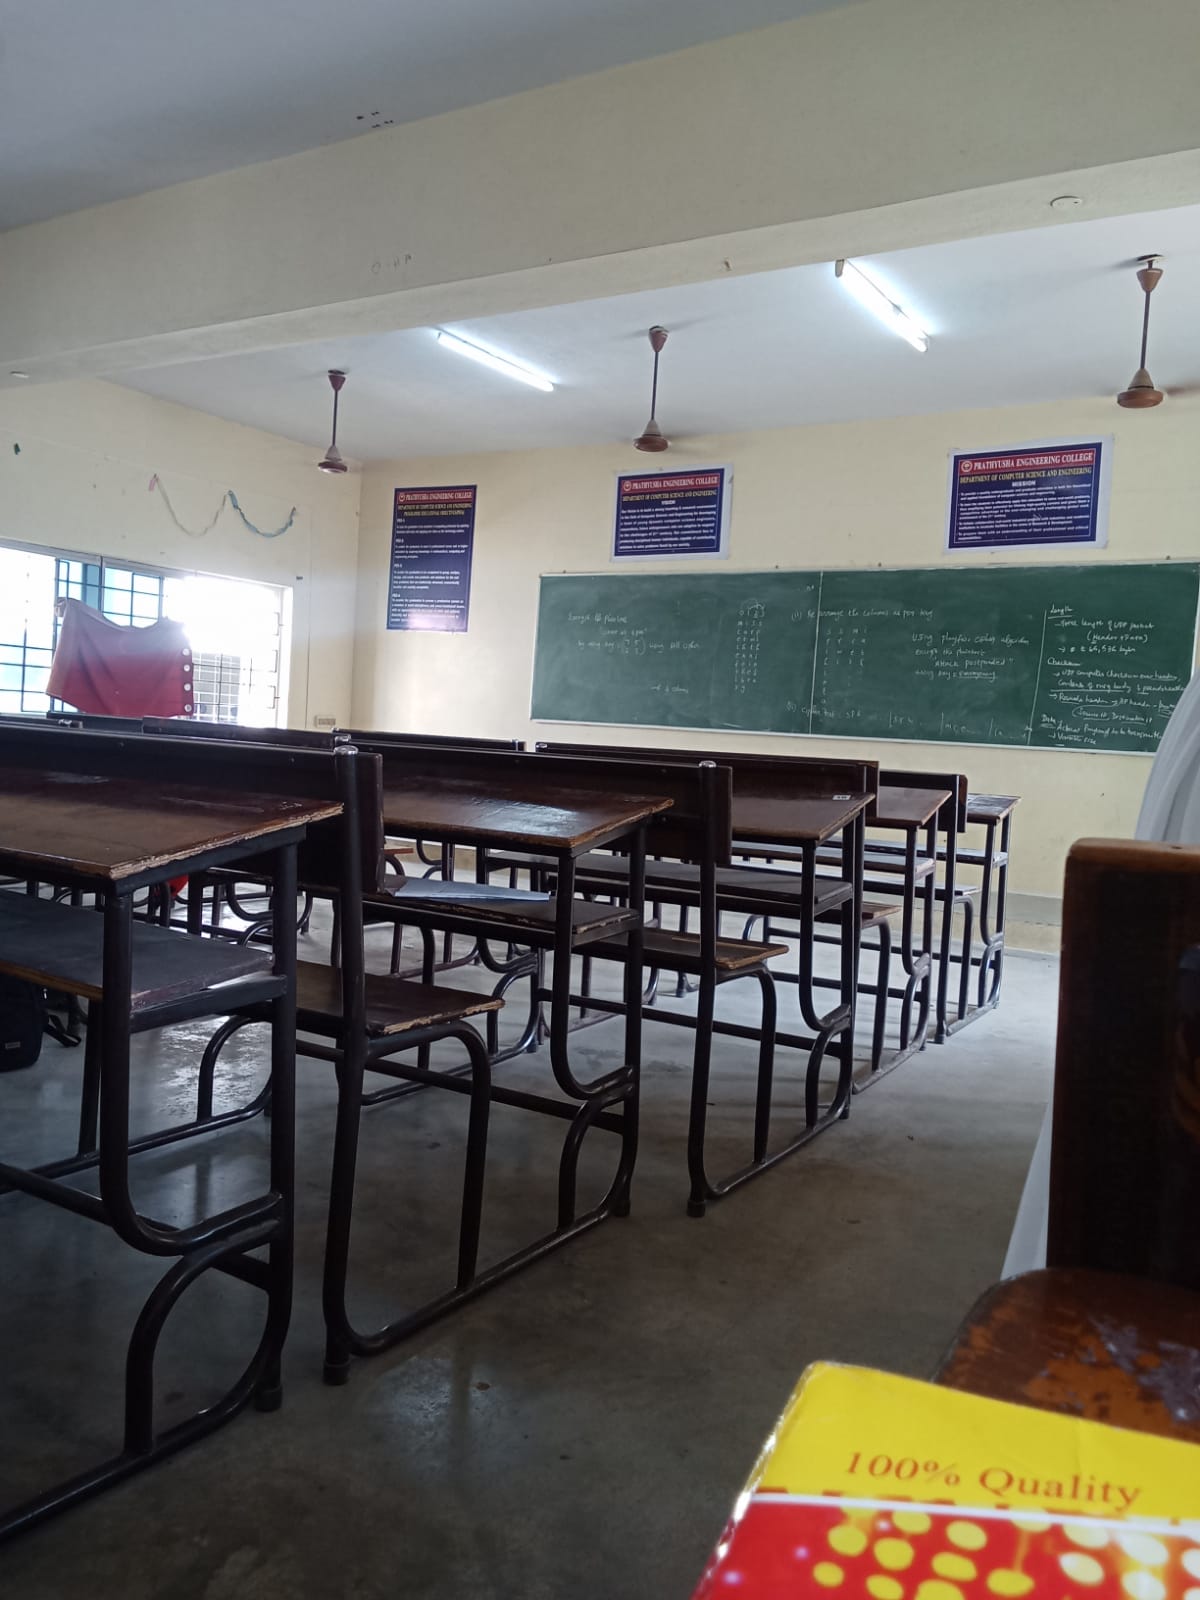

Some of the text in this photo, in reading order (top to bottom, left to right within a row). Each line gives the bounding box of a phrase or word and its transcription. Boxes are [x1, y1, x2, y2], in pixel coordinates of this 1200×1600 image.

[974, 452, 1093, 471] PRATHYUSHA ENGINEERING COLLEGE
[663, 478, 695, 488] ENGINEERING
[696, 476, 718, 485] COLLEGE
[960, 466, 1092, 484] DEPARTMENT OF COMPUTER SCIENCE AND ENGINEERING
[845, 1452, 1143, 1513] 100% Quality
